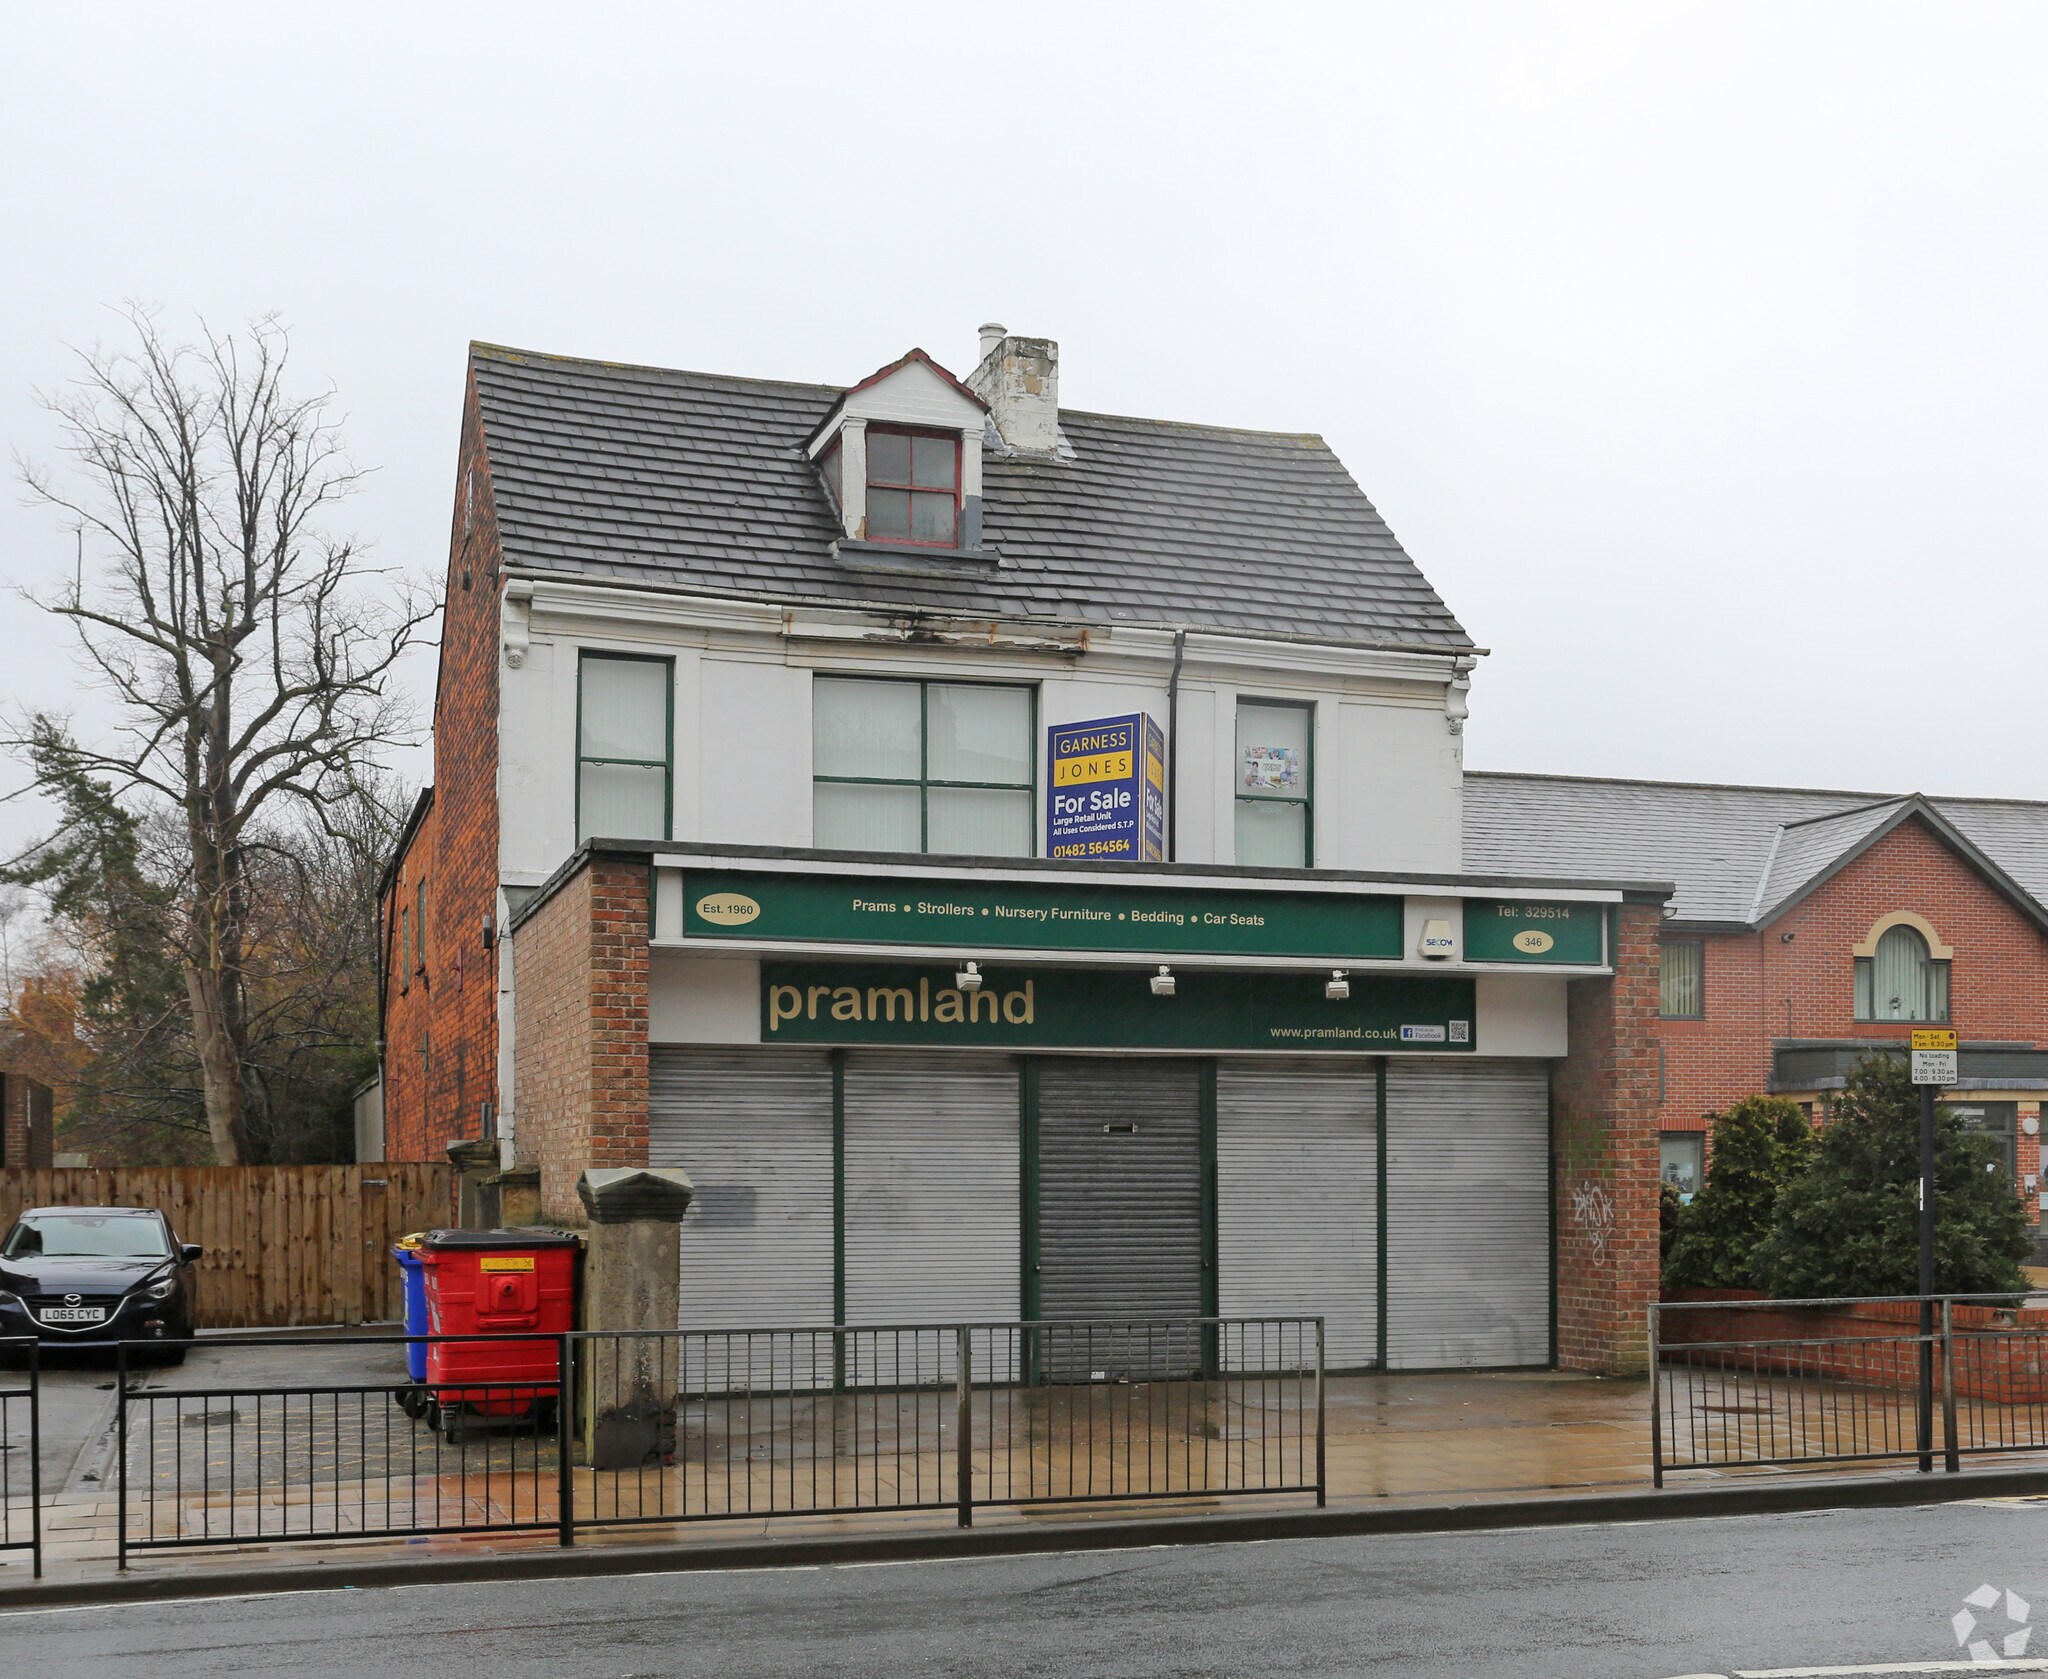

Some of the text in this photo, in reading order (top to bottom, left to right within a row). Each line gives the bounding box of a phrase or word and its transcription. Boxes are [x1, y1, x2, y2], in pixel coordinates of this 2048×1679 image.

[1060, 732, 1127, 754] GARNESS
[1060, 758, 1126, 780] JONES
[1054, 788, 1132, 815] For Sale
[1053, 811, 1112, 826] Large Retail Unit
[1053, 820, 1134, 836] All Uses Considered S.T.P
[1053, 843, 1086, 858] 01482
[1088, 839, 1130, 856] 564564
[703, 903, 754, 916] Est. 1960
[852, 899, 1265, 926] Prams Strollers Nursery Furniture Bedding Car Seats
[1497, 905, 1570, 919] Tel: 329514
[1426, 938, 1453, 946] SECOM
[1524, 937, 1542, 946] 346
[768, 976, 1035, 1032] pramland
[1270, 1027, 1398, 1040] www.pramland.co.uk
[45, 1310, 99, 1320] LO65 CYC
